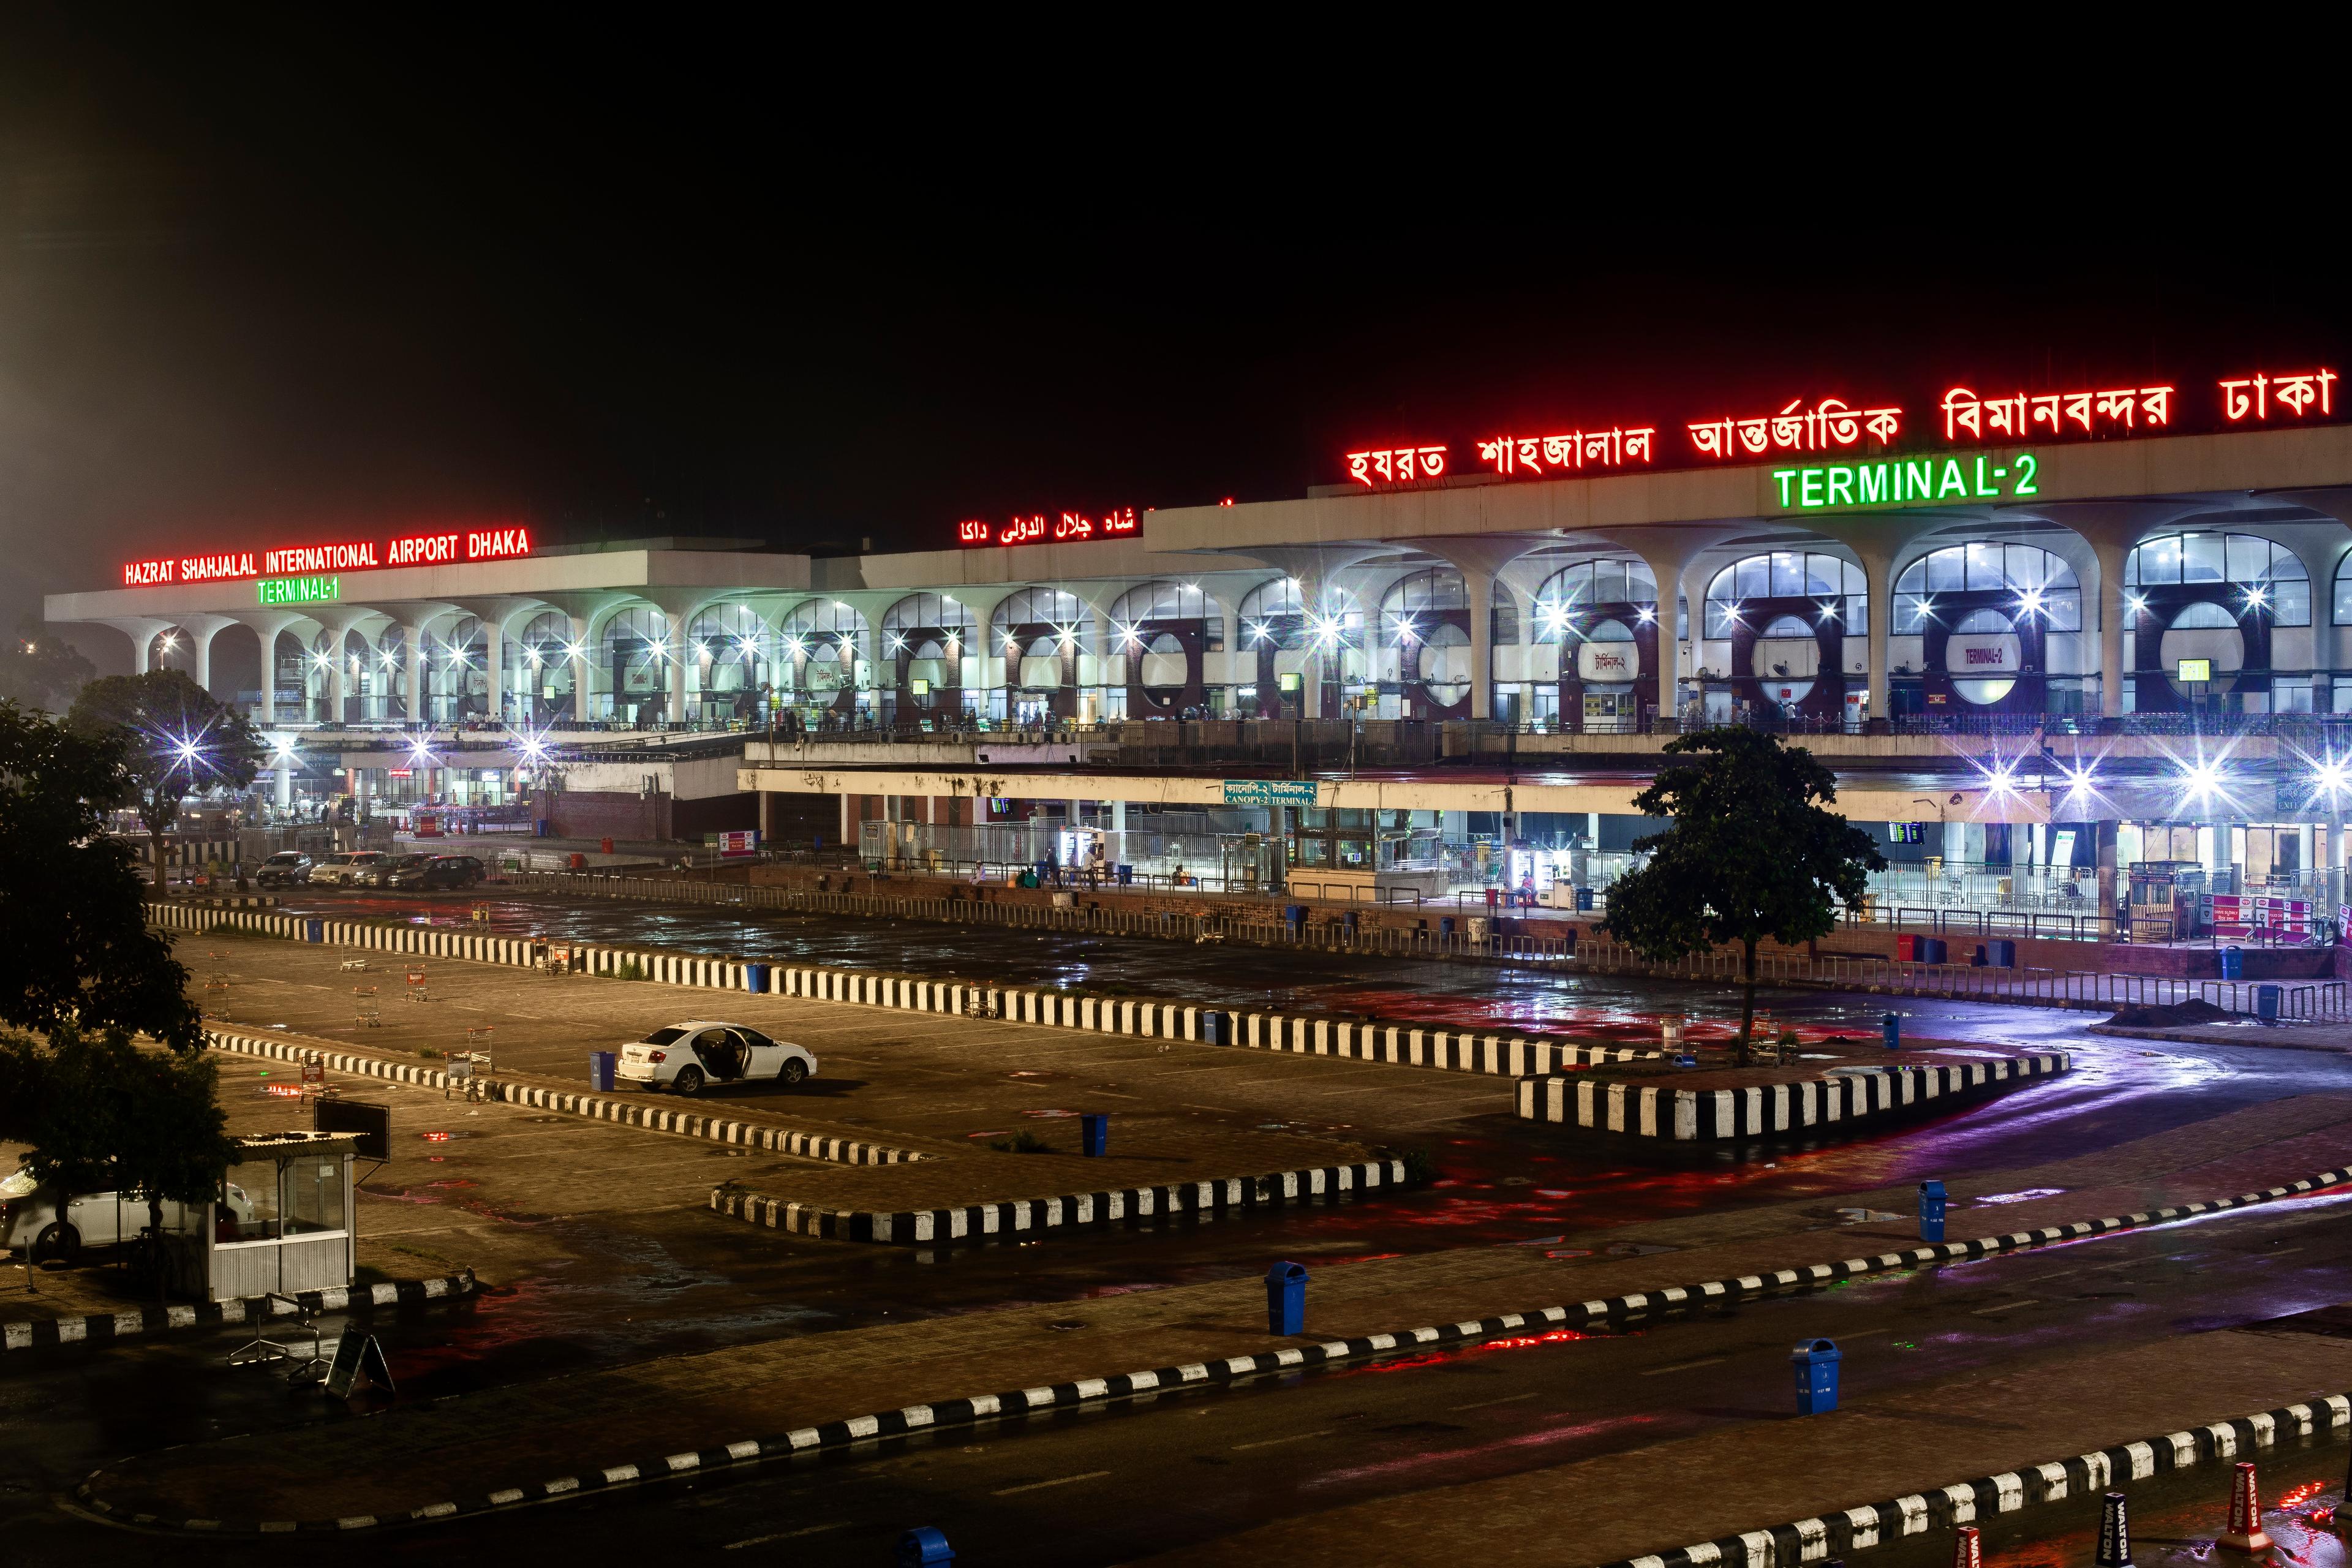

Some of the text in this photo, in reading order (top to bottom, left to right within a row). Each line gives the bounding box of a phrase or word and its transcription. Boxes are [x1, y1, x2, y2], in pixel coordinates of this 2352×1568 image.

[1348, 369, 2337, 486] হযরত শাহজালাল আন্তর্জাতিক বিমানবন্দর ঢাকা
[1774, 456, 2035, 507] TERMINAL-2
[961, 521, 987, 540] داكا
[1056, 513, 1091, 538] جلال
[1106, 508, 1133, 531] شاه
[126, 529, 528, 584] HAZRAT SHAHJALAL INTERNATIONAL AIRPORT DHAKA
[258, 576, 338, 603] TERMINAL-1
[1595, 653, 1626, 670] টার্মিনাল-২
[1855, 662, 1862, 671] 5
[1966, 648, 2002, 664] TERMINAL-2
[1225, 782, 1268, 795] ক্যানোপি-২
[2233, 1470, 2245, 1528] WALTON
[2247, 1470, 2258, 1528] WALTON
[2103, 1502, 2114, 1560] WALTON
[2117, 1501, 2127, 1561] WALTON
